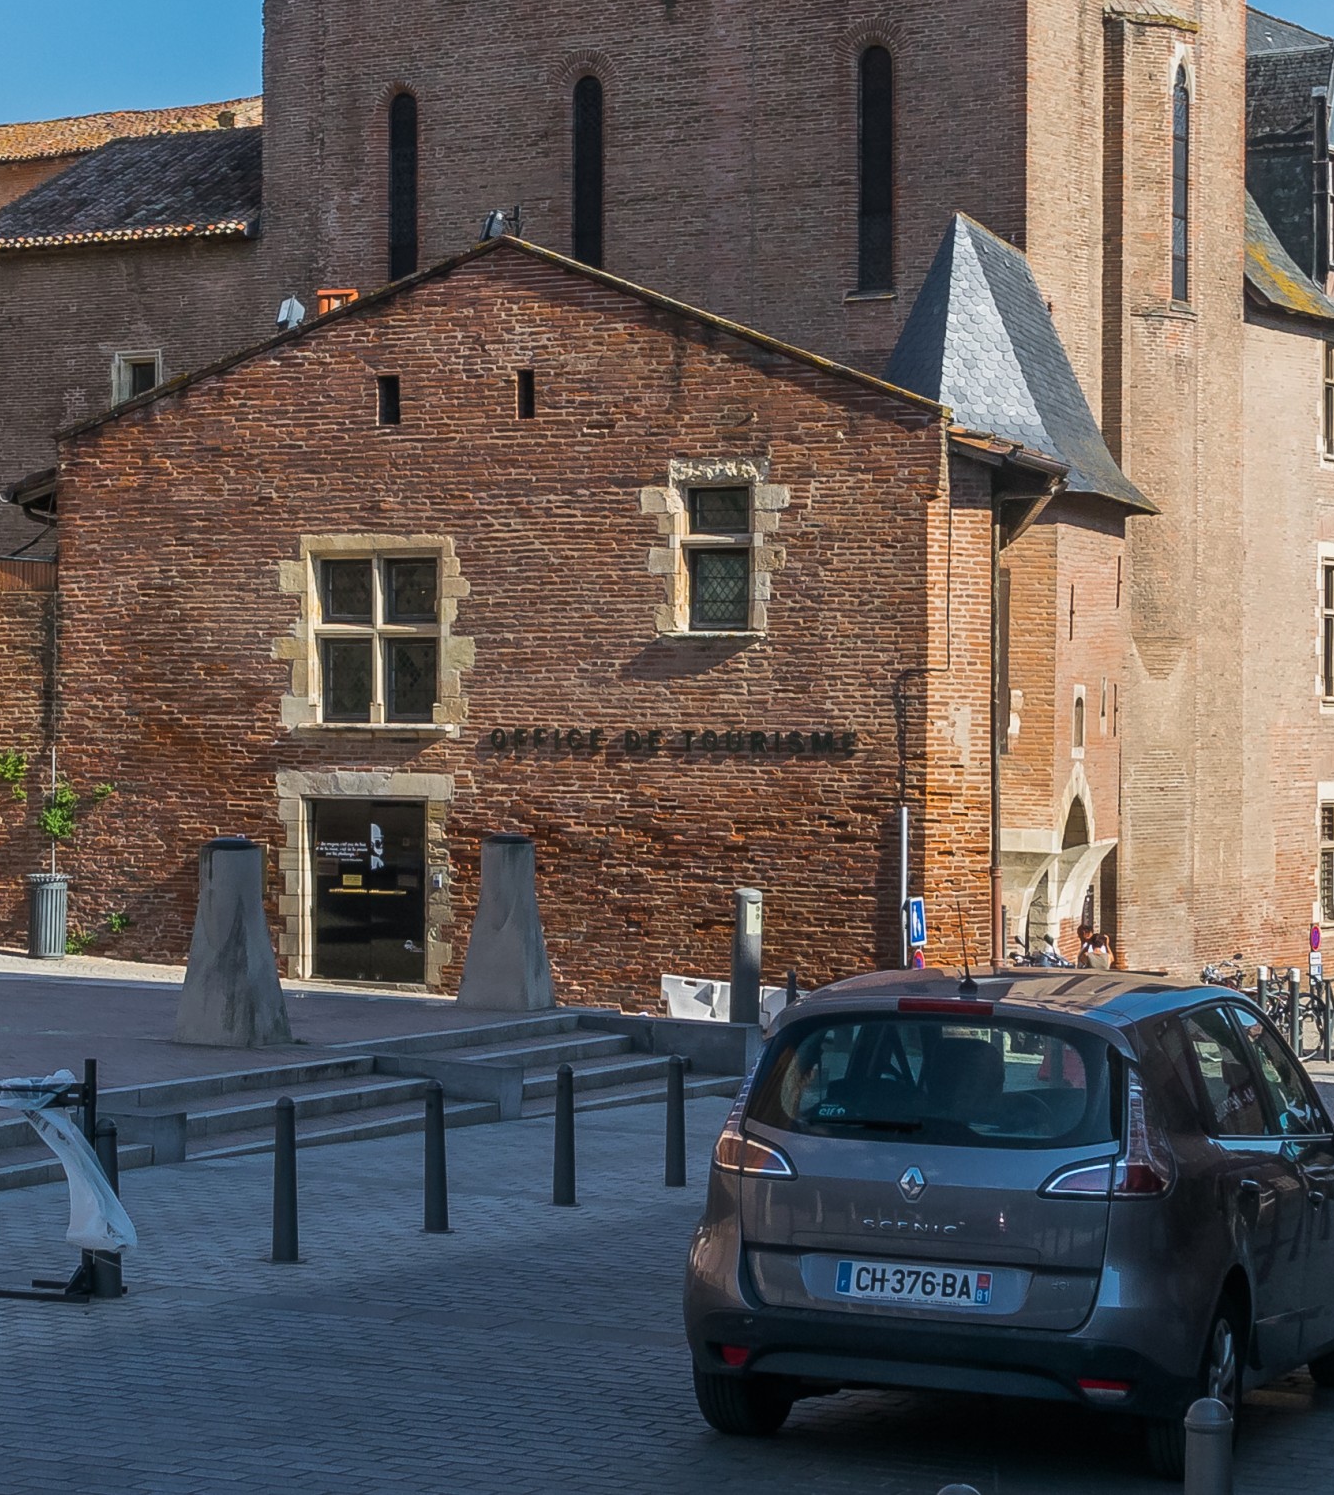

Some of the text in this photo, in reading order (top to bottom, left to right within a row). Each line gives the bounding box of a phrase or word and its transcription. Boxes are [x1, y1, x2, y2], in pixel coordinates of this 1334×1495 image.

[490, 727, 857, 756] OFFICE DE TOURISME
[855, 1266, 971, 1300] CH-376-BA
[976, 1289, 989, 1303] 81
